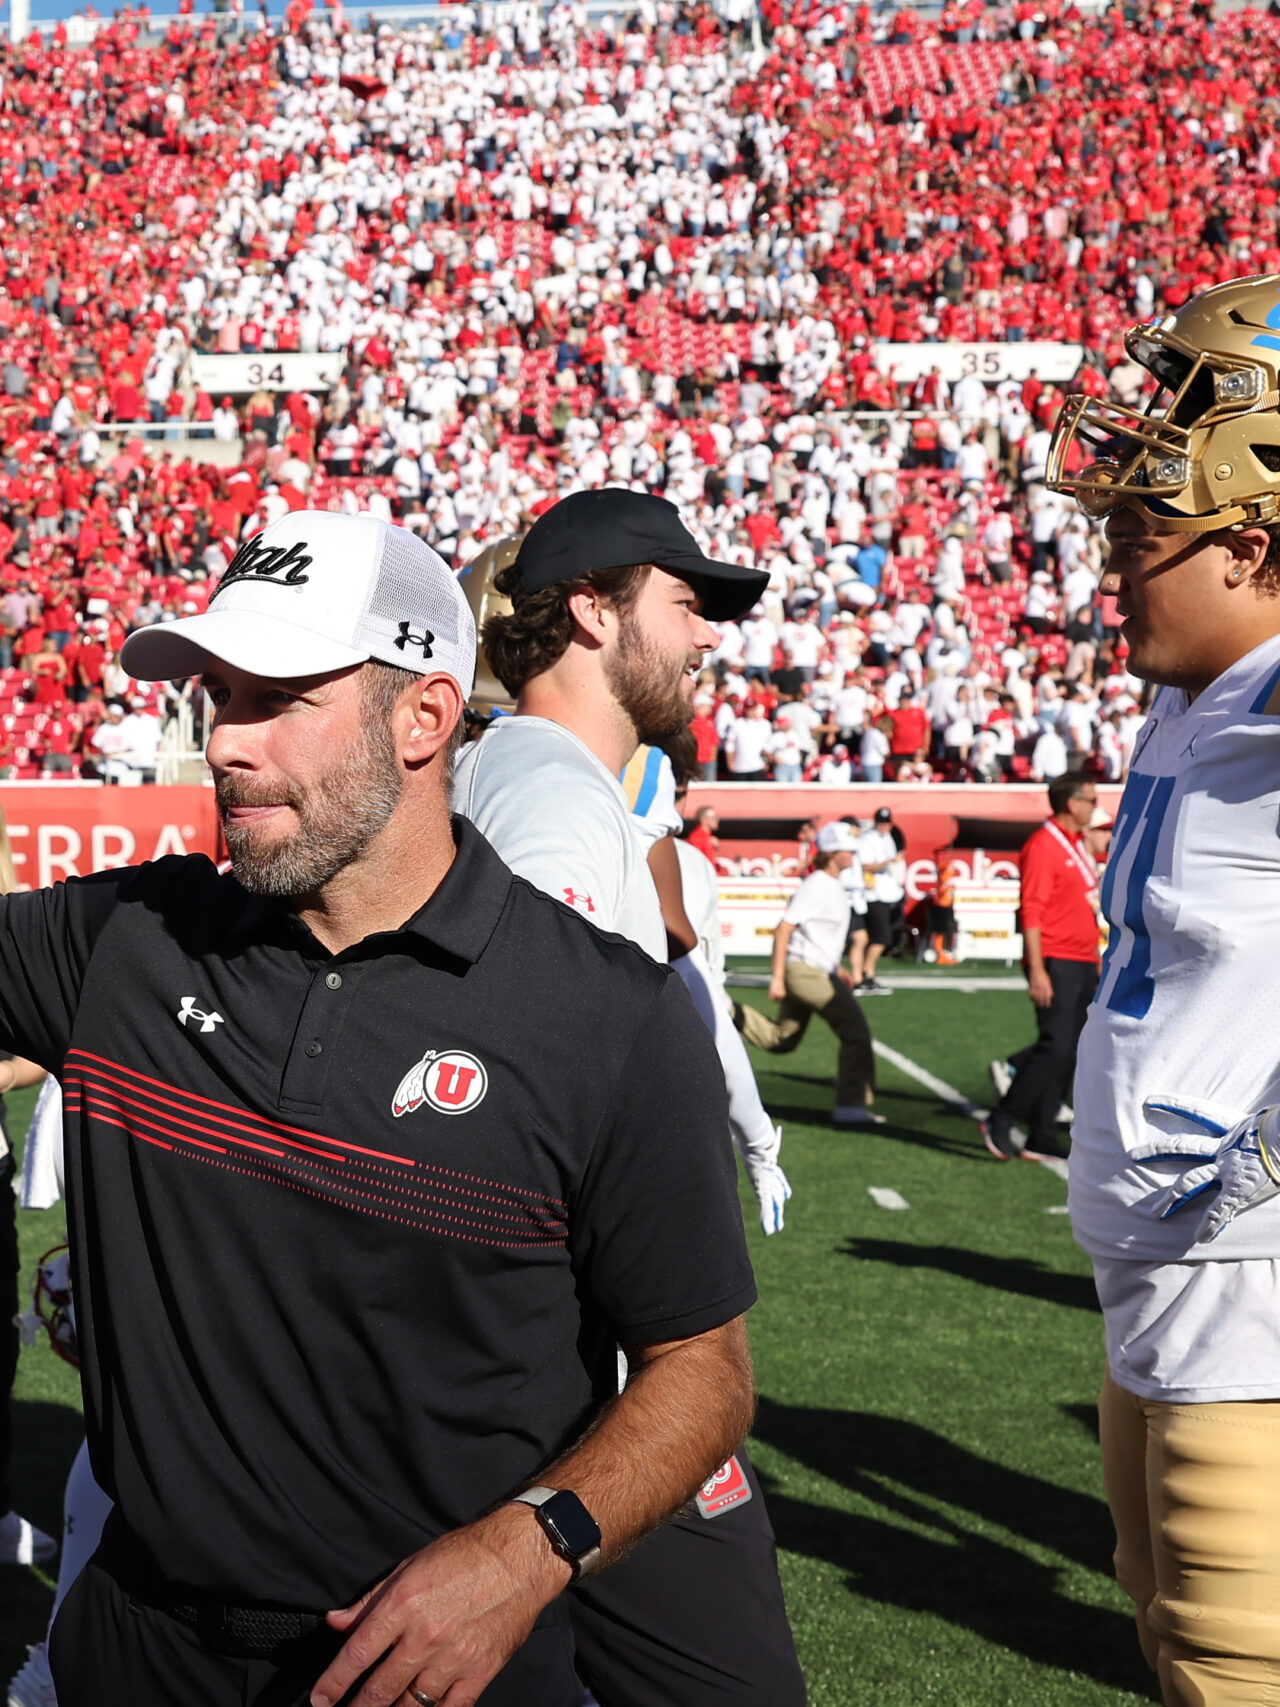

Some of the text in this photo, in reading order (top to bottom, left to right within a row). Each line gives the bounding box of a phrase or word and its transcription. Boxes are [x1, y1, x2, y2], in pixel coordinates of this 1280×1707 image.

[248, 363, 285, 385] 34
[962, 351, 1001, 375] 35
[434, 1061, 478, 1106] U
